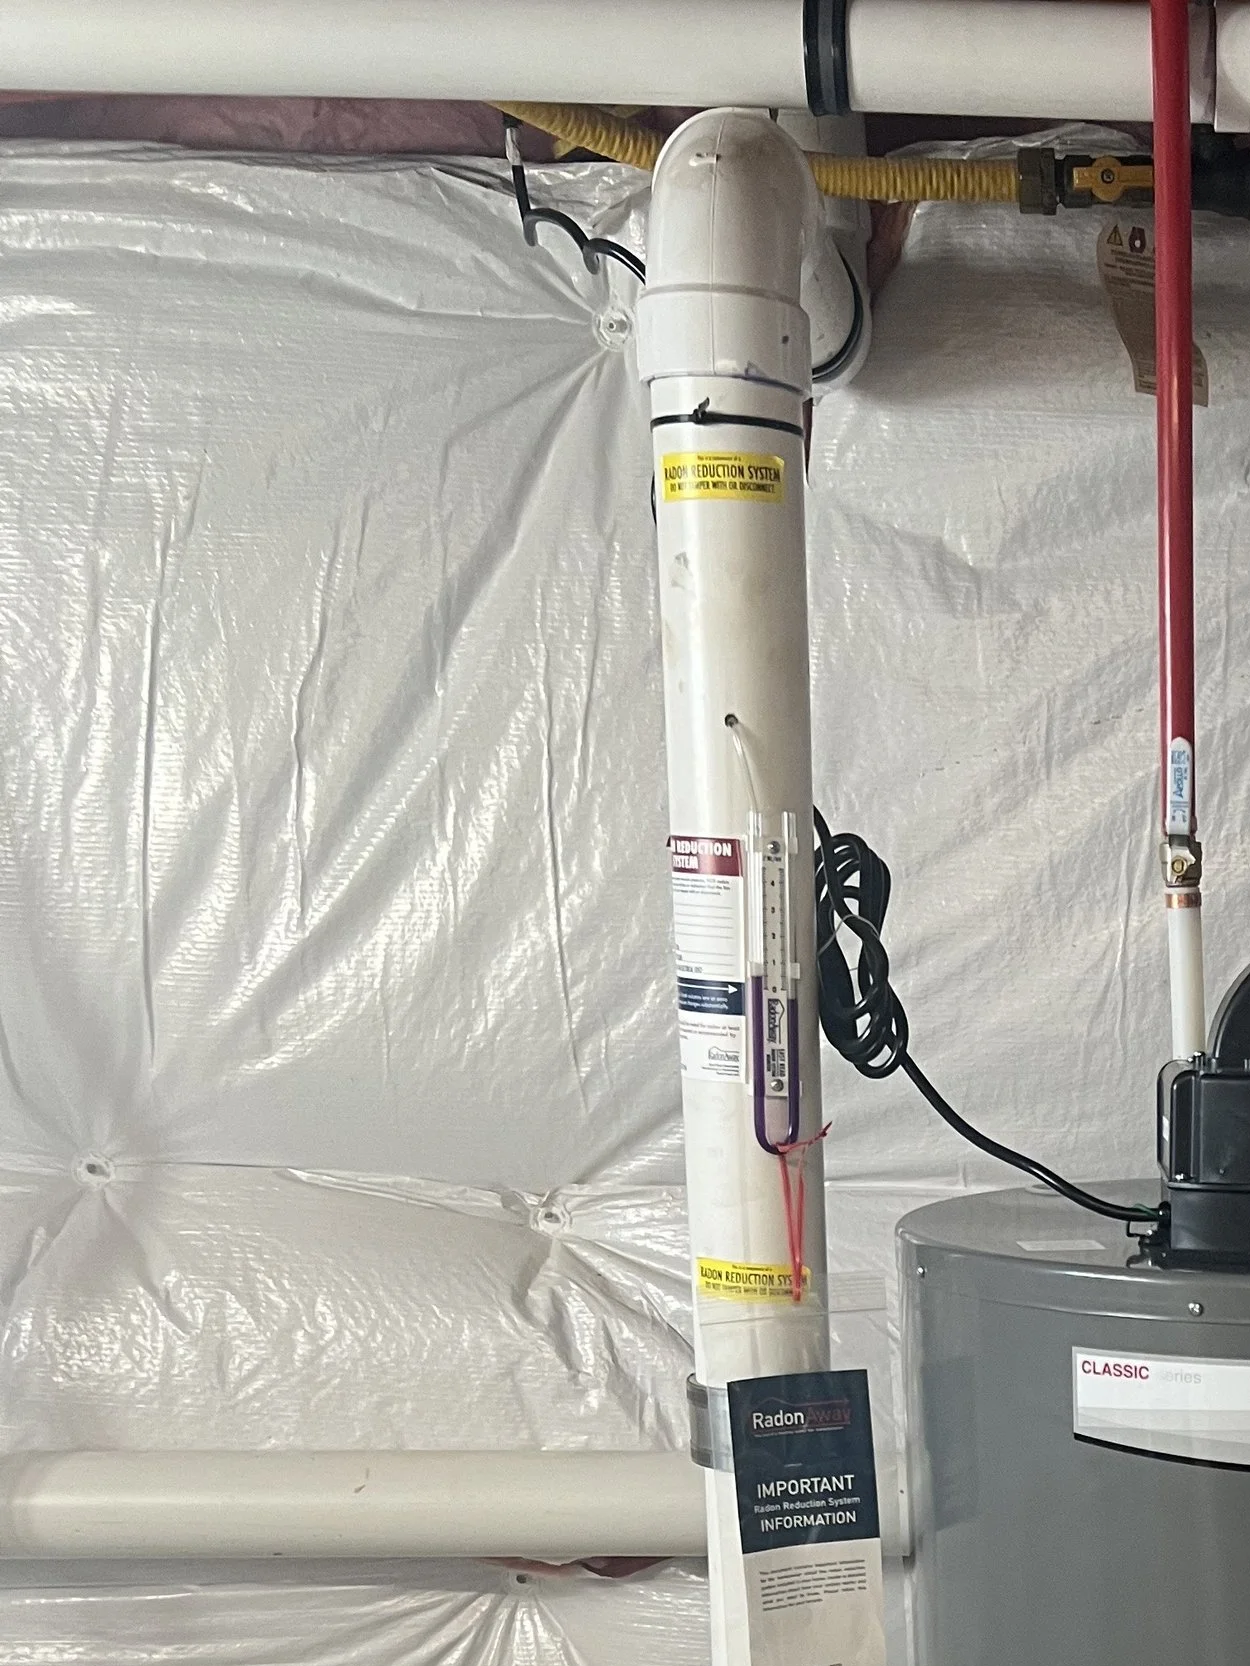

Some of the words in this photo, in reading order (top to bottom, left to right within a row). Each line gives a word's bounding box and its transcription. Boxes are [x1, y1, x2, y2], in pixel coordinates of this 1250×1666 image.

[691, 464, 744, 479] REDUCTION
[748, 465, 781, 482] SYSTEM
[677, 840, 732, 857] REDUCTION
[673, 855, 698, 869] SYSTEM
[700, 1266, 722, 1281] RADON
[726, 1272, 774, 1286] REDUCTION
[1081, 1360, 1150, 1380] CLASSIC
[1160, 1369, 1202, 1384] eries
[757, 1474, 855, 1499] IMPORTANT
[754, 1503, 781, 1514] Radon
[783, 1498, 827, 1510] Reduction
[828, 1496, 861, 1507] System
[761, 1510, 857, 1532] INFORMATION
